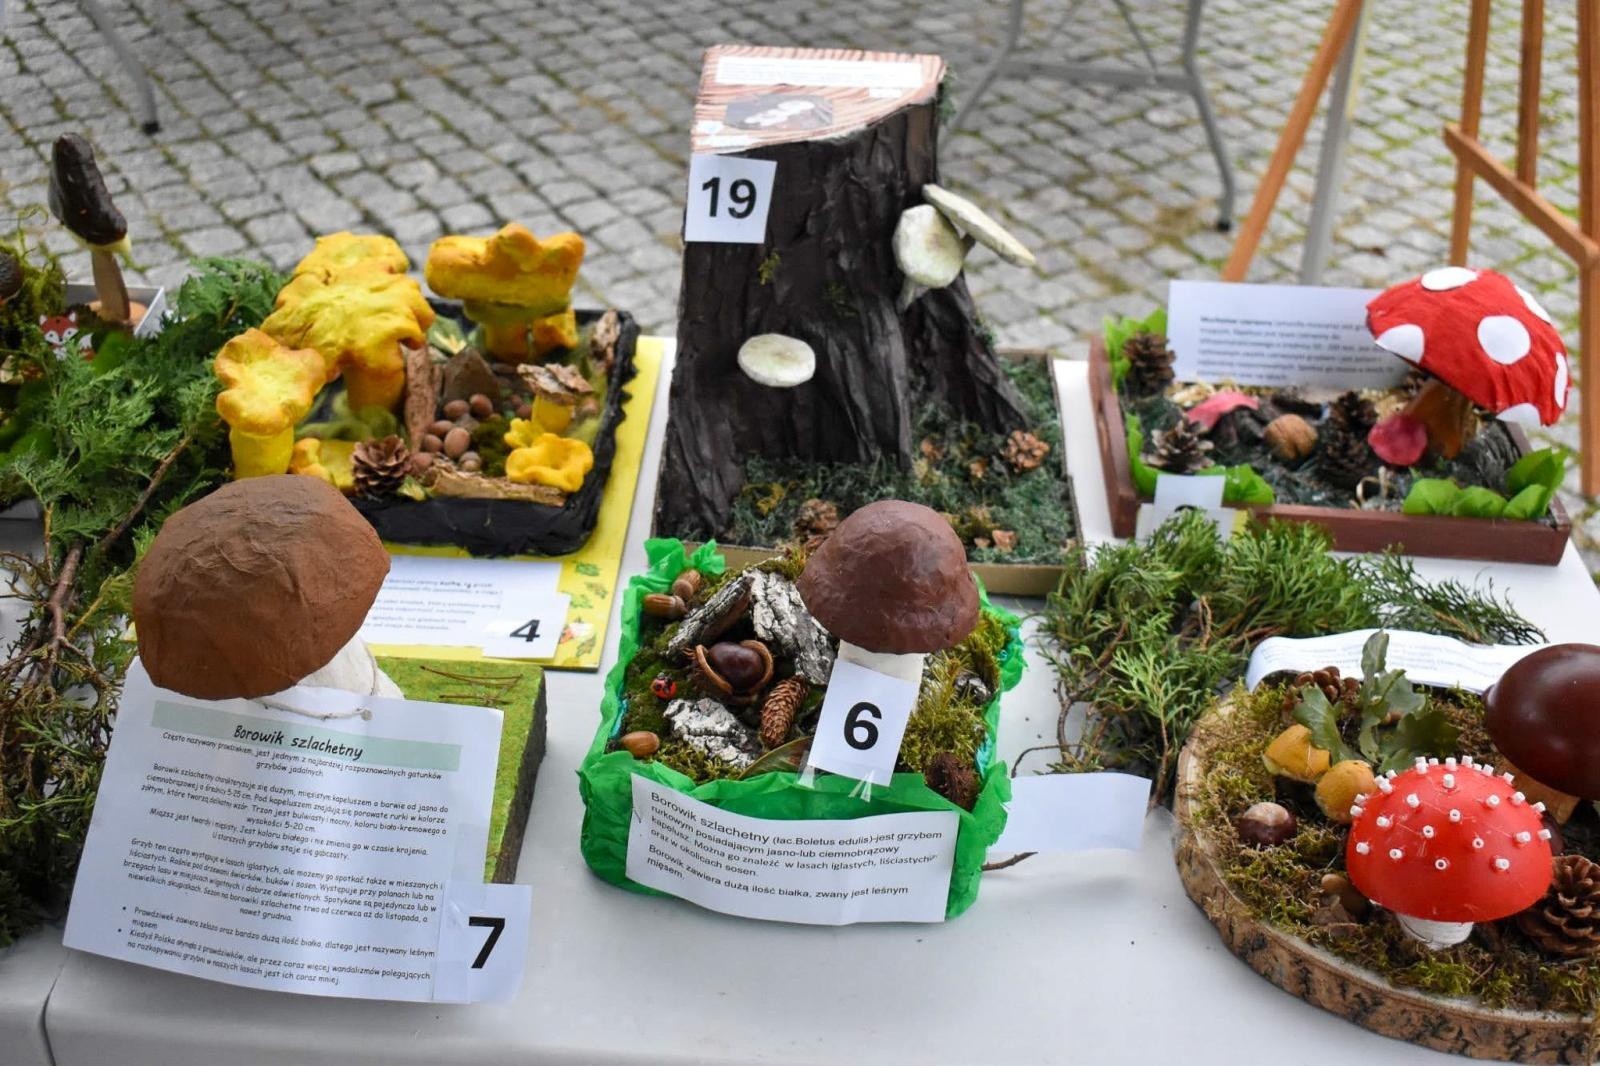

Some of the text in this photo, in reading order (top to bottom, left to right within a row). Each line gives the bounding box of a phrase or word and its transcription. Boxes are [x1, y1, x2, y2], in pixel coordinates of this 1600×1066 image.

[701, 176, 757, 219] 19
[509, 618, 541, 643] 4
[843, 701, 882, 750] 6
[233, 724, 363, 761] Borowik szlachetny
[255, 748, 270, 758] jest
[271, 753, 300, 762] jednym
[345, 763, 406, 778] rozpoznawalnych
[407, 769, 442, 780] gatunków
[256, 761, 287, 771] grzybów
[153, 762, 180, 774] Borowik
[181, 769, 214, 783] szlachetny
[257, 784, 268, 792] się
[332, 793, 372, 807] kapeluszem
[381, 800, 406, 811] barwie
[407, 803, 417, 811] od
[418, 803, 438, 813] jasno
[439, 805, 449, 814] do
[246, 816, 282, 829] wysokości
[284, 820, 303, 831] 5-20
[251, 803, 273, 815] Trzon
[274, 808, 290, 819] jest
[354, 819, 378, 831] koloru
[379, 822, 440, 837] biało-kremowego
[441, 828, 448, 836] o
[254, 793, 268, 804] Pod
[269, 796, 312, 811] kapeluszem
[353, 809, 388, 821] porowate
[390, 812, 409, 822] rurki
[418, 814, 446, 825] kolorze
[651, 791, 698, 823] Borowik
[699, 817, 770, 846] szlachetny
[897, 831, 942, 843] grzybem
[174, 813, 190, 822] jest
[239, 825, 256, 835] Jest
[257, 829, 281, 841] koloru
[281, 832, 309, 845] białego
[325, 838, 351, 850] zmienia
[351, 843, 362, 852] go
[371, 844, 395, 854] czasie
[248, 839, 279, 852] grzybów
[280, 843, 301, 855] staje
[650, 806, 900, 859] rurkowym posiadającym jasno-lub ciemnobrązowy
[131, 837, 153, 850] Grzyb
[155, 842, 168, 851] ten
[283, 866, 296, 876] ale
[325, 874, 335, 883] go
[335, 873, 365, 885] spotkać
[366, 876, 388, 886] także
[396, 879, 438, 890] mieszanych
[650, 829, 669, 843] oraz
[670, 839, 678, 848] w
[679, 845, 722, 870] okolicach
[693, 839, 725, 857] Można
[727, 852, 740, 862] go
[742, 857, 780, 868] znaleźć
[797, 861, 829, 870] lasach
[830, 858, 877, 871] iglastych,
[264, 873, 290, 885] buków
[319, 882, 357, 897] Występuje
[358, 887, 377, 899] przy
[378, 887, 410, 900] polanach
[411, 888, 424, 900] lub
[425, 892, 435, 901] na
[649, 843, 685, 869] Borowik
[686, 864, 721, 885] zawiera
[724, 879, 749, 893] dużą
[752, 884, 776, 895] ilość
[815, 890, 849, 901] zwany
[850, 887, 869, 899] jest
[871, 886, 908, 897] leśnym
[246, 884, 272, 896] dobrze
[322, 894, 362, 907] Spotykane
[363, 899, 372, 909] są
[373, 899, 416, 912] pojedynczo
[417, 901, 429, 911] lub
[430, 905, 437, 913] w
[259, 897, 301, 912] szlachetne
[331, 906, 361, 918] czerwca
[373, 909, 384, 920] do
[234, 928, 260, 940] bardzo
[281, 934, 299, 945] ilość
[324, 940, 353, 952] dlatego
[354, 943, 371, 954] jest
[371, 945, 407, 957] nazywany
[409, 946, 435, 959] leśnym
[468, 916, 506, 969] 7
[246, 953, 258, 963] ale
[259, 955, 282, 966] przez
[283, 959, 305, 970] coraz
[331, 964, 379, 976] wandalizmów
[380, 967, 431, 981] polegających
[263, 968, 282, 979] jest
[281, 971, 294, 980] ich
[295, 973, 317, 983] coraz
